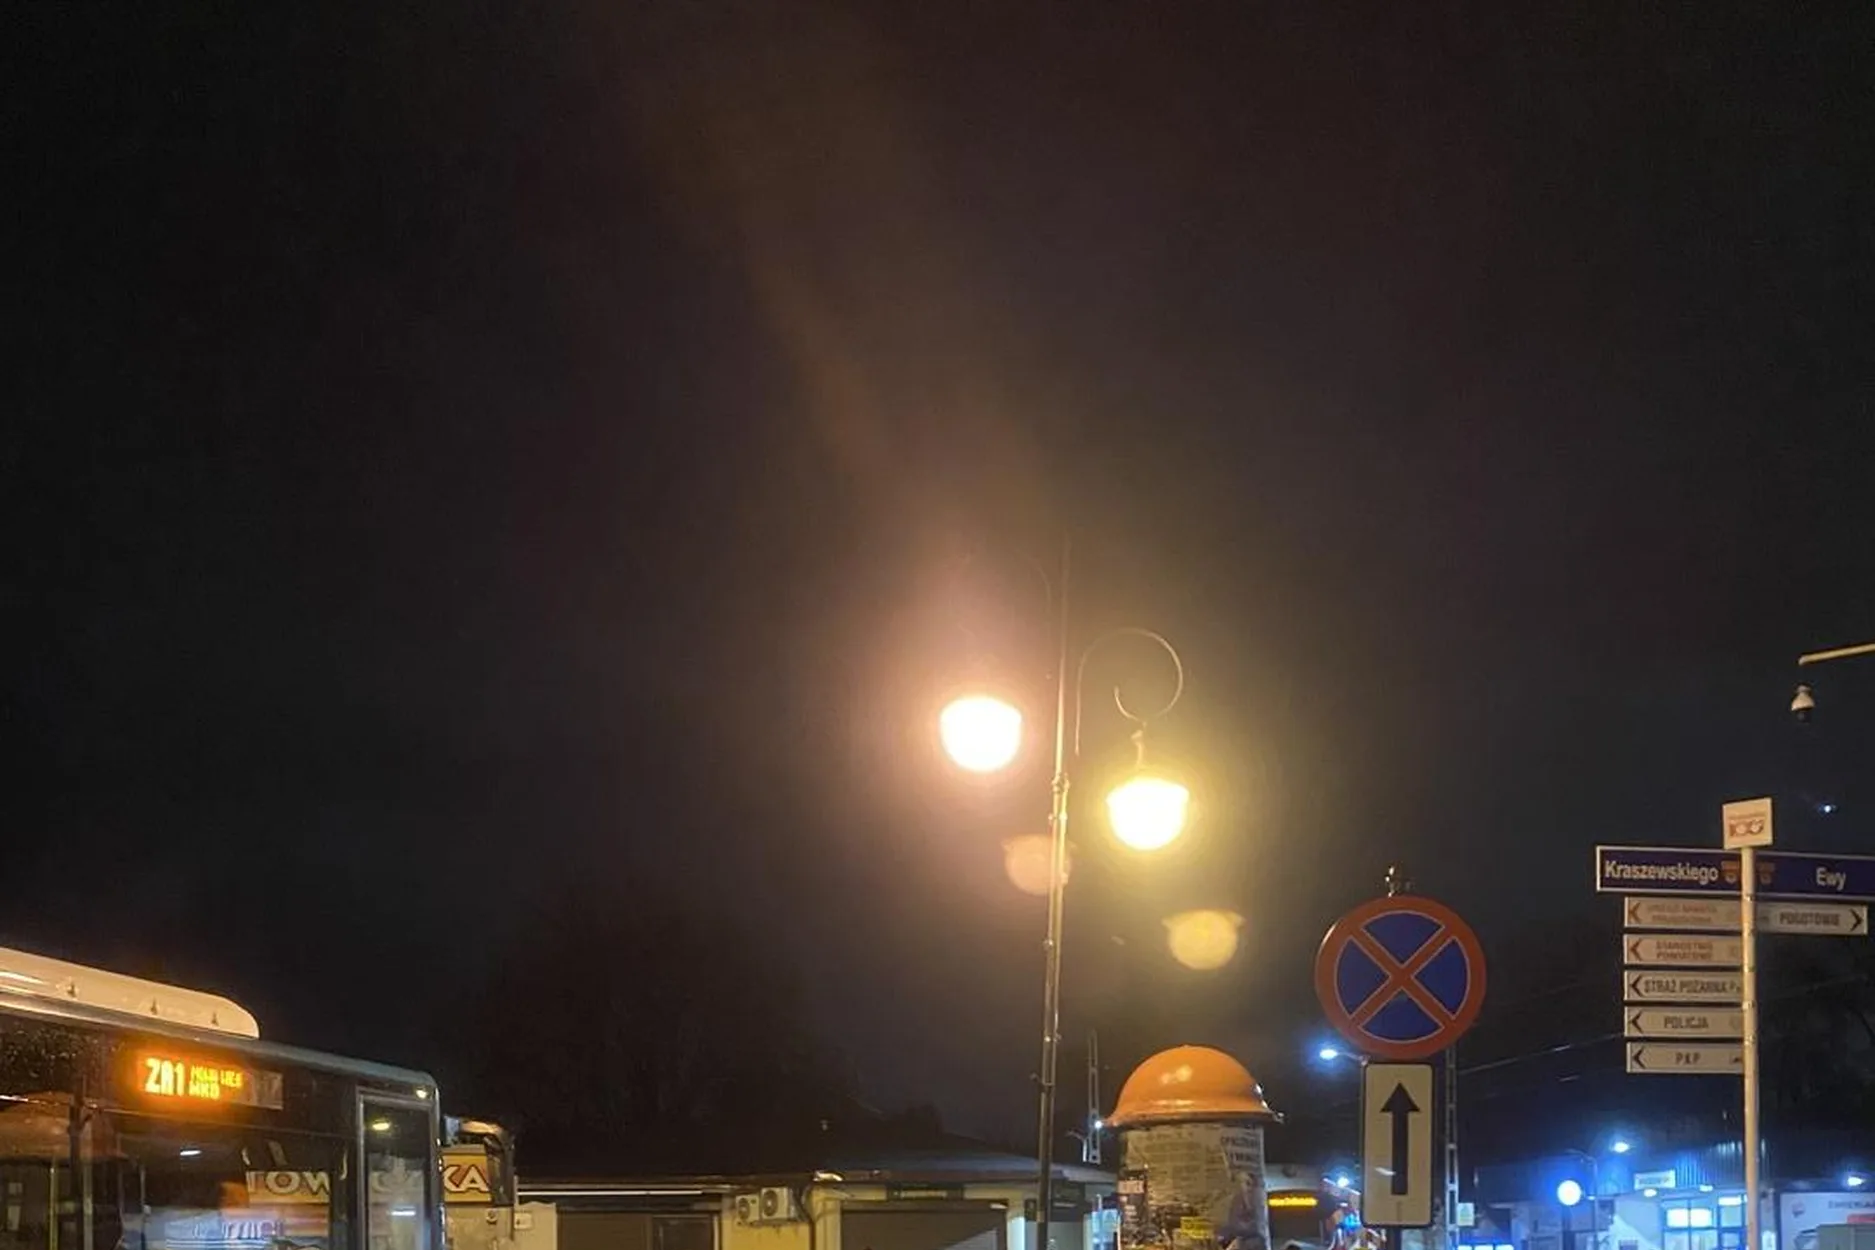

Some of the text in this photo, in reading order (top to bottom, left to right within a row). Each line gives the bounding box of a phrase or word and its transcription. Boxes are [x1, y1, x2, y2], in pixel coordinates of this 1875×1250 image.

[1605, 860, 1719, 885] Kraszewskiego
[1815, 867, 1847, 891] Ewy
[1643, 979, 1677, 993] STRAŻ
[1663, 1015, 1709, 1029] POLICJA
